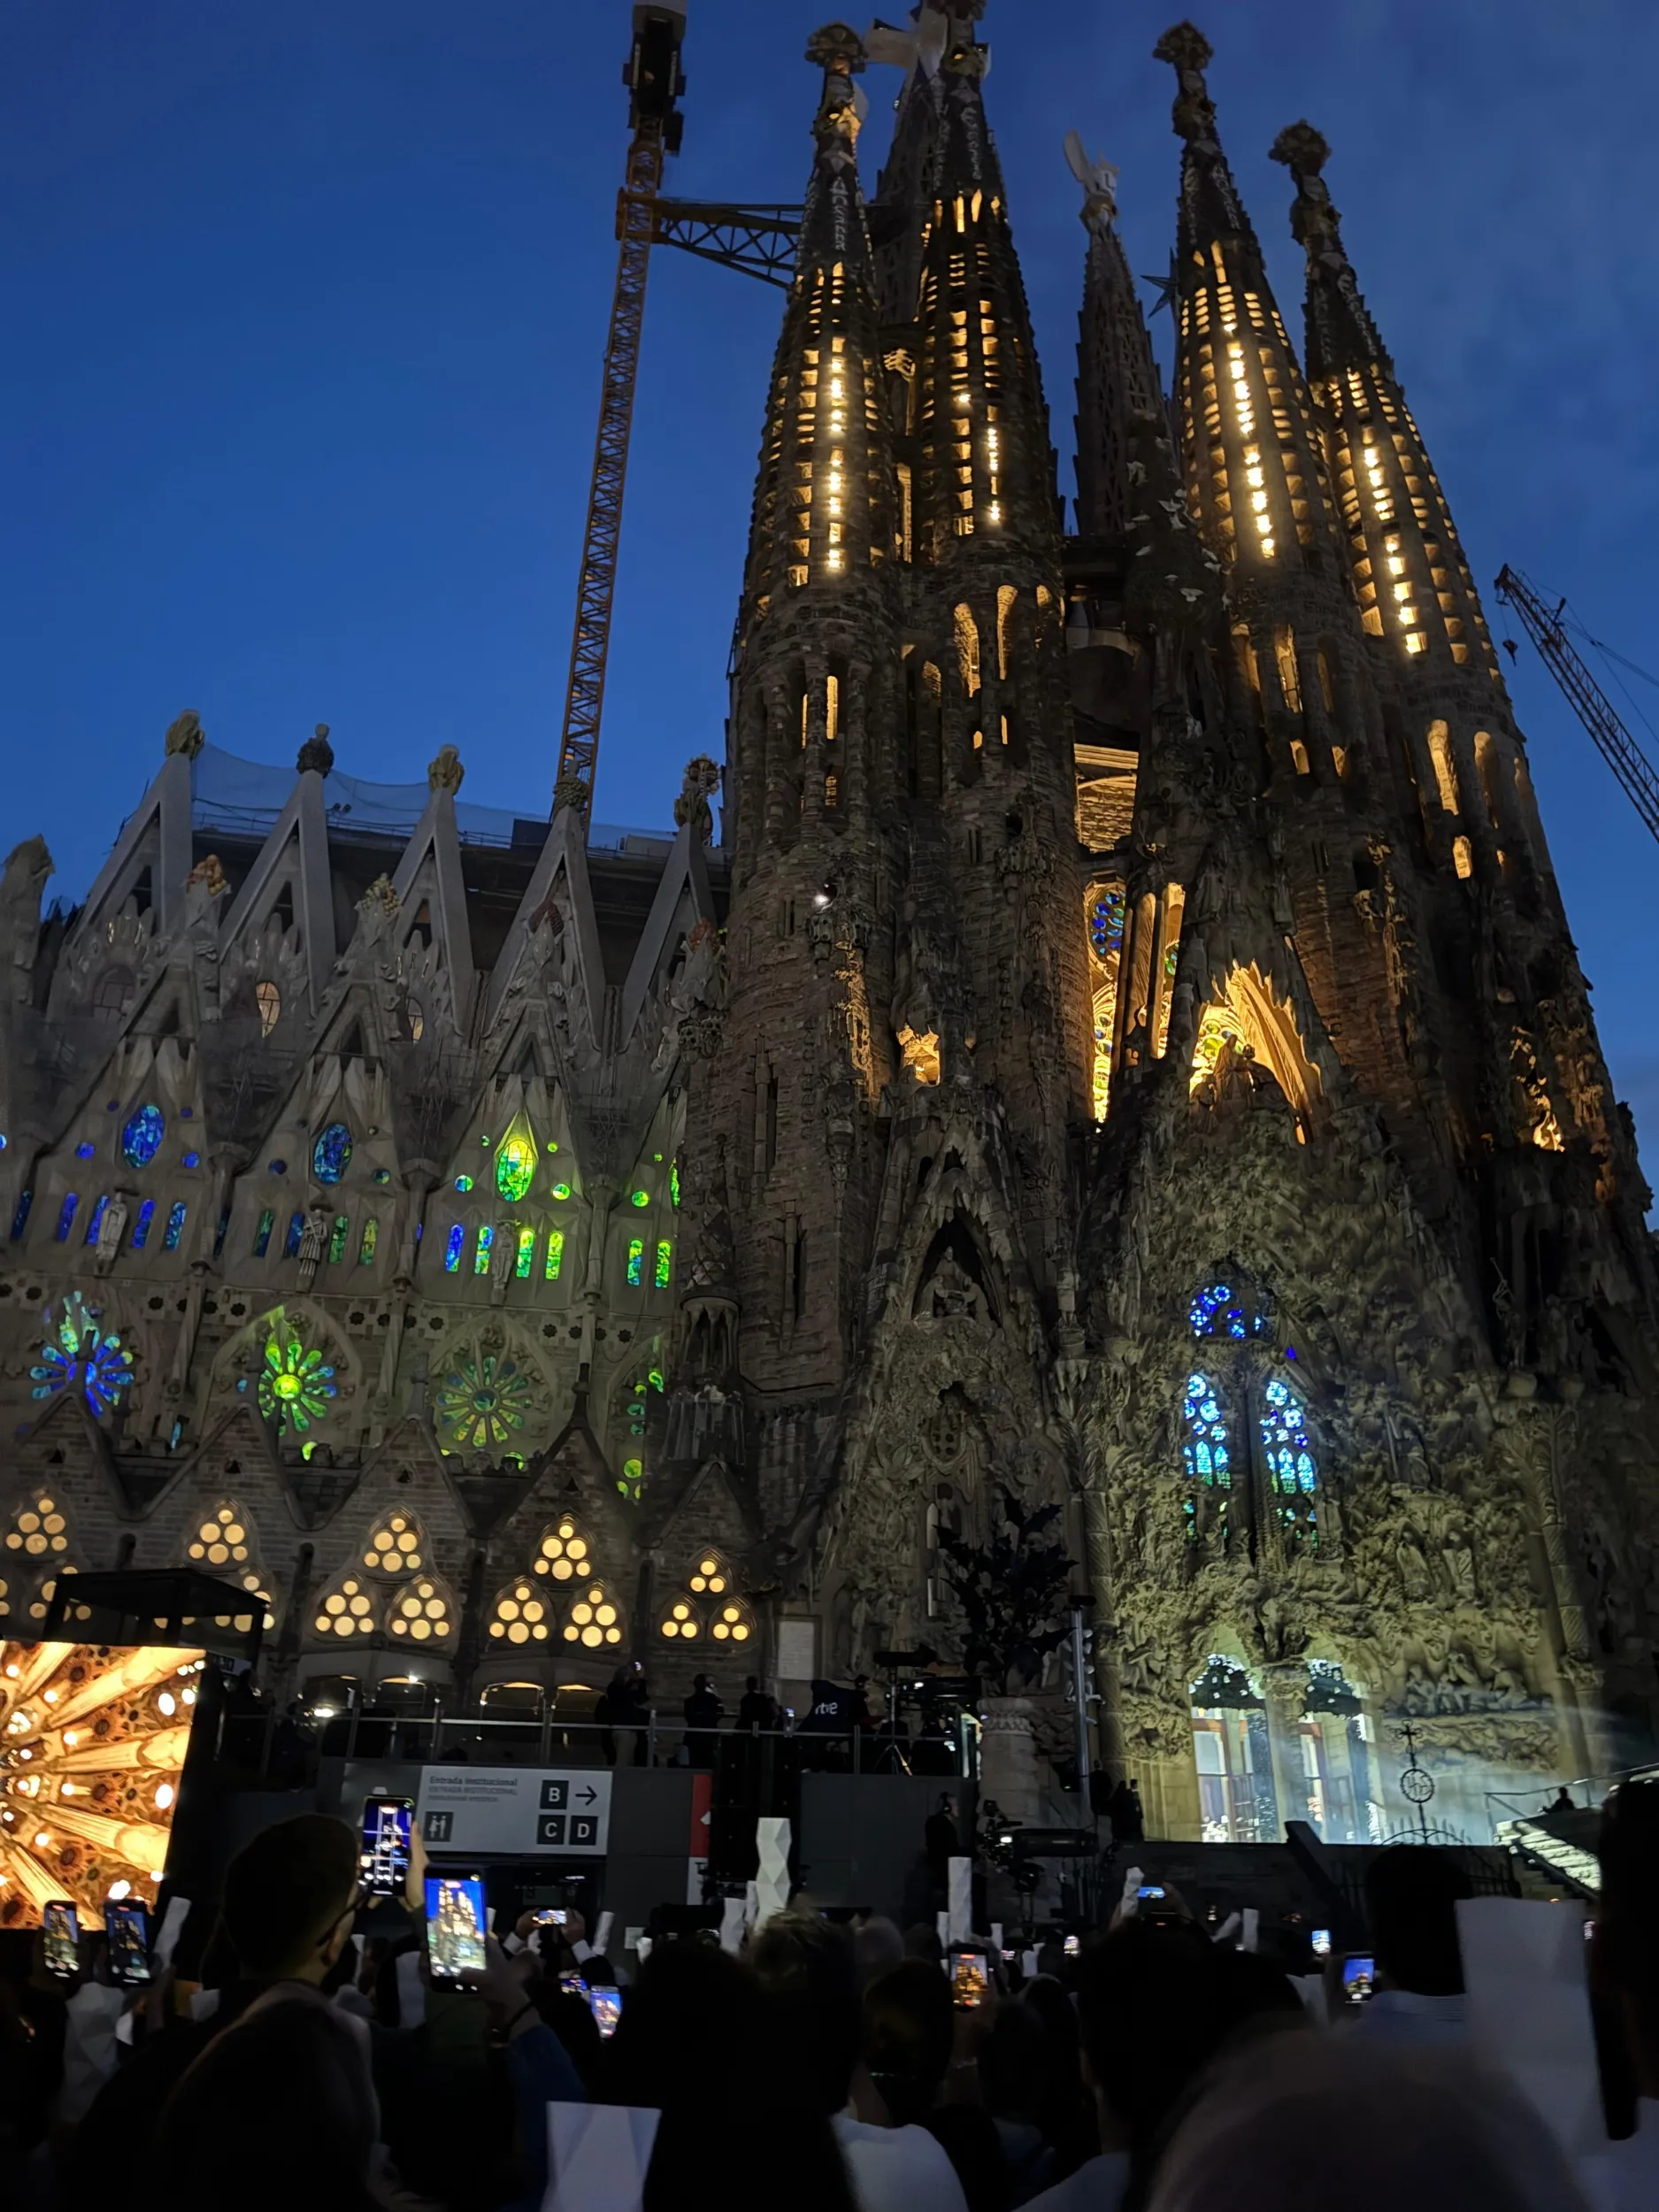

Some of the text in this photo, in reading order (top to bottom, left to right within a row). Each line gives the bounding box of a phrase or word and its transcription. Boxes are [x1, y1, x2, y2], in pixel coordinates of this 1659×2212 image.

[815, 1701, 838, 1715] rtve
[429, 1776, 463, 1785] Entrada
[549, 1787, 560, 1802] B
[545, 1823, 590, 1838] C D
